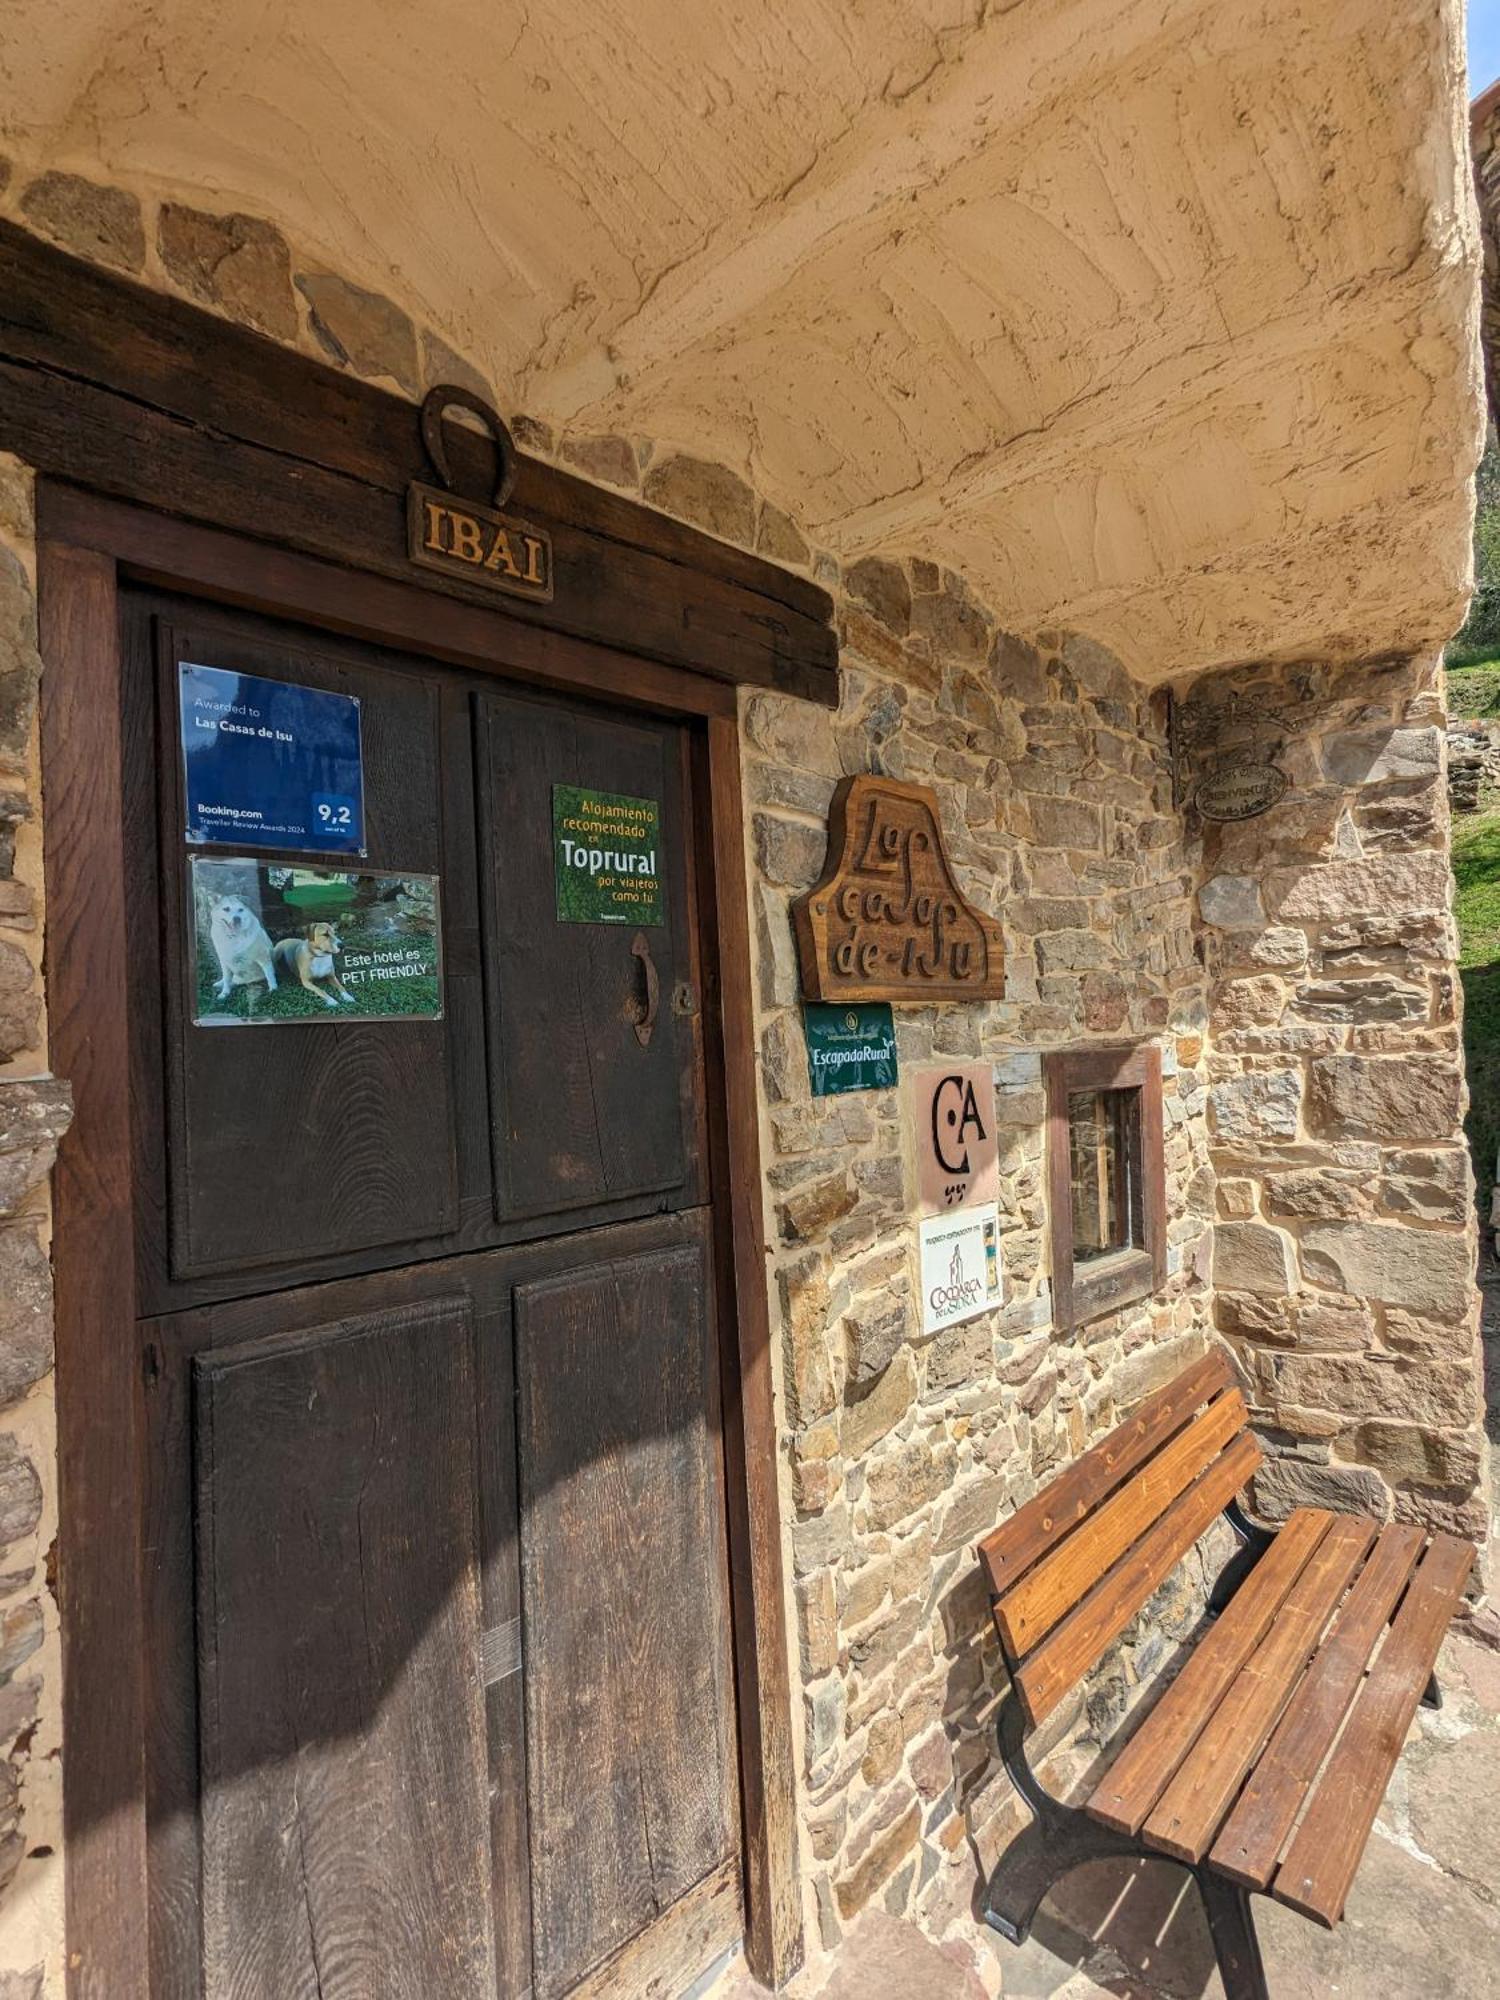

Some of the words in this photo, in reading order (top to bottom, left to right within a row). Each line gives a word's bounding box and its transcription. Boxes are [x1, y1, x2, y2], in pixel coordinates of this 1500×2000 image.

[424, 502, 543, 584] IBAI
[194, 698, 246, 715] Awarded
[249, 707, 261, 718] to
[195, 716, 217, 730] Las
[219, 720, 256, 736] Casas
[258, 727, 273, 739] de
[276, 730, 293, 743] Isu
[197, 803, 263, 820] Booking.com
[318, 804, 351, 825] 9,2
[581, 799, 656, 823] Alojamiento
[233, 820, 259, 831] Review
[260, 823, 286, 833] Awards
[287, 825, 306, 835] 2024
[563, 818, 645, 839] recomendado
[854, 799, 930, 890] Las
[560, 839, 656, 876] Toprural
[598, 876, 616, 889] por
[619, 877, 658, 890] viajeros
[611, 891, 640, 903] como
[343, 953, 372, 968] Este
[373, 949, 404, 964] hotel
[405, 949, 421, 961] es
[342, 970, 367, 985] PET
[369, 962, 427, 983] FRIENDLY
[813, 1038, 893, 1068] EscapadaRural
